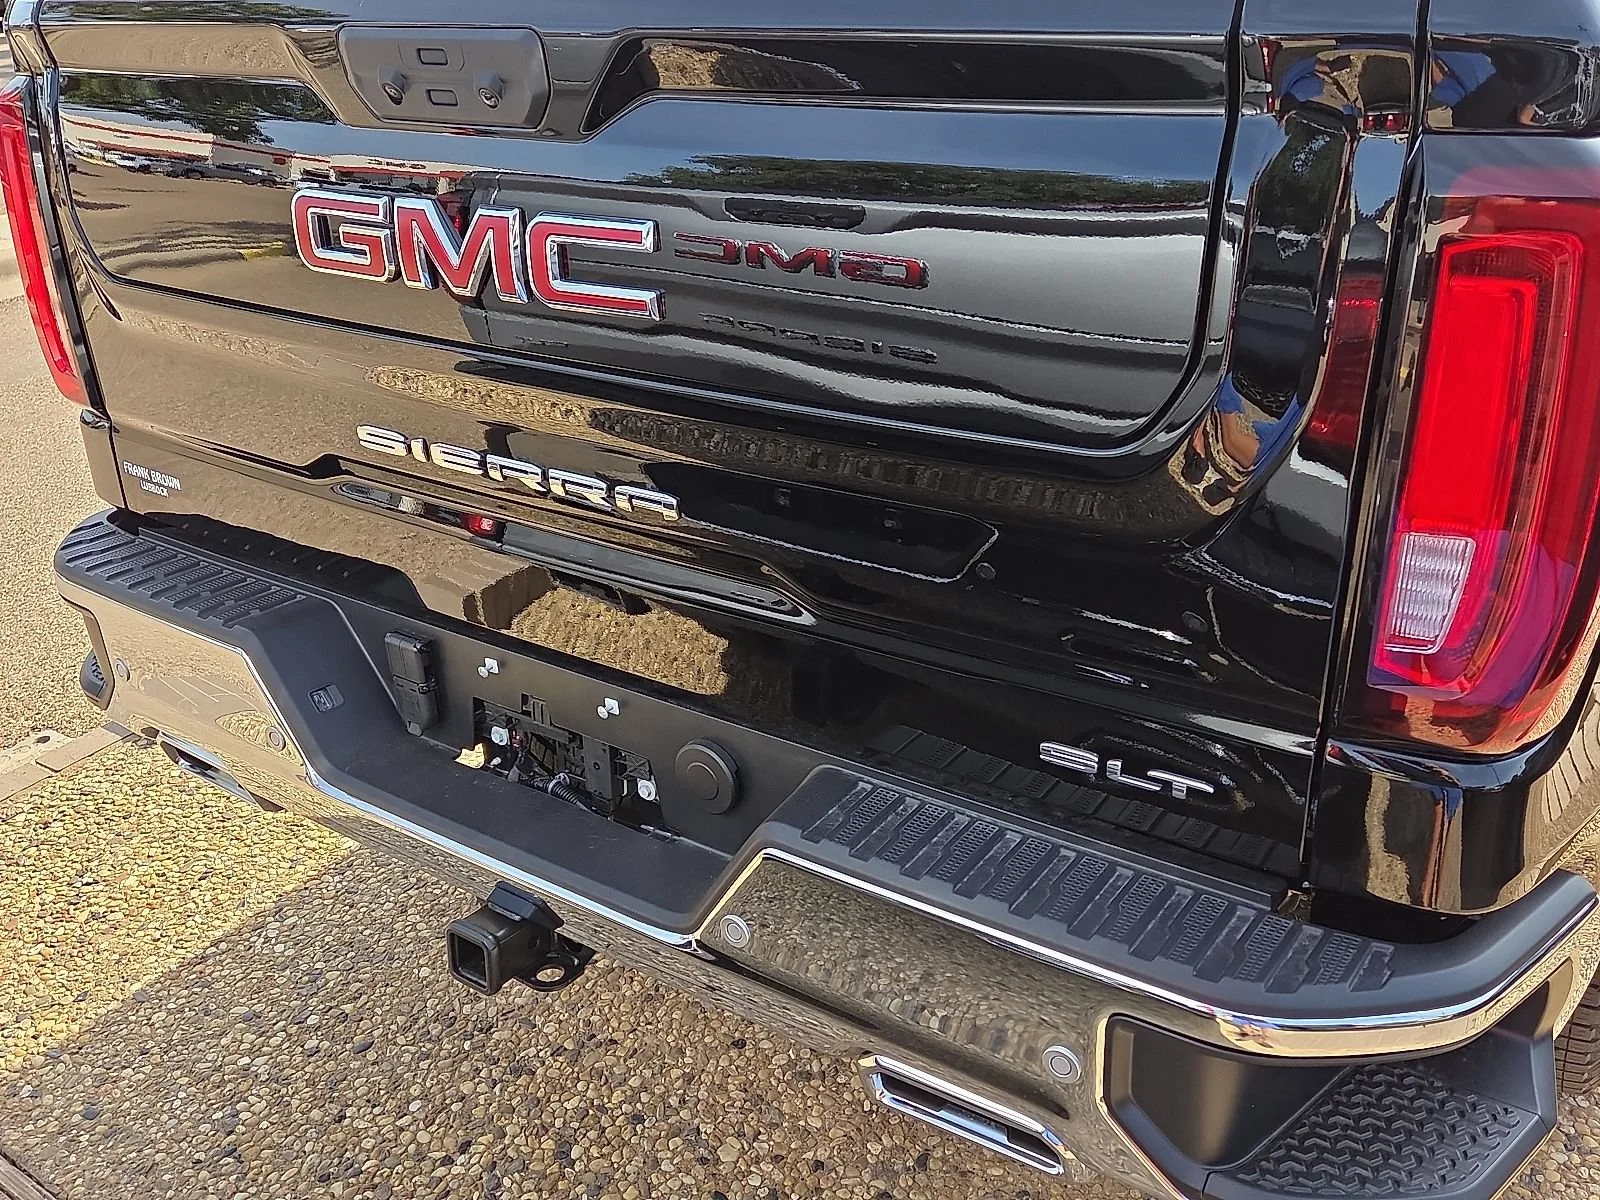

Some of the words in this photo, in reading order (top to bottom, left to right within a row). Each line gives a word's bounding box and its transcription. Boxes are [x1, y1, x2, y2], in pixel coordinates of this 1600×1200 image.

[291, 188, 665, 320] GMC
[123, 461, 150, 480] FRANK
[150, 470, 181, 491] BROWN
[356, 424, 681, 521] SIERRA
[1040, 742, 1214, 799] SLT
